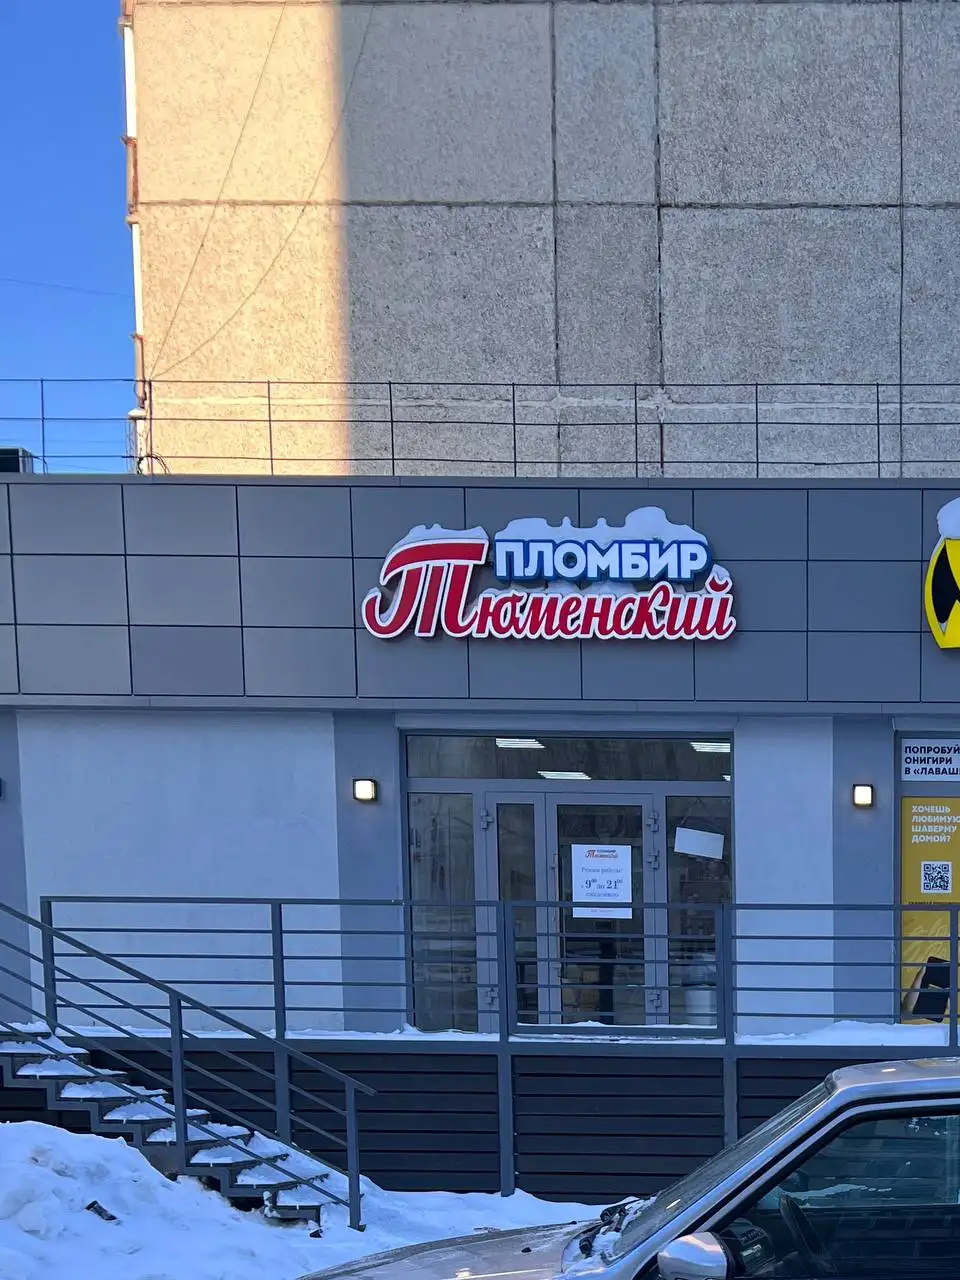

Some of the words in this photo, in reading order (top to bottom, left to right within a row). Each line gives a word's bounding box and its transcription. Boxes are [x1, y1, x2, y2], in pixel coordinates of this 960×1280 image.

[495, 540, 709, 581] ПЛОМБИР
[362, 538, 736, 640] Тюменский
[904, 744, 960, 754] ПОПРОБУЙ
[904, 756, 952, 765] ОНИГИРИ
[904, 767, 911, 775] В
[911, 805, 951, 813] ХОЧЕШЬ
[911, 825, 957, 833] ШАВЕРМУ
[911, 834, 951, 843] ДОМОЙ?
